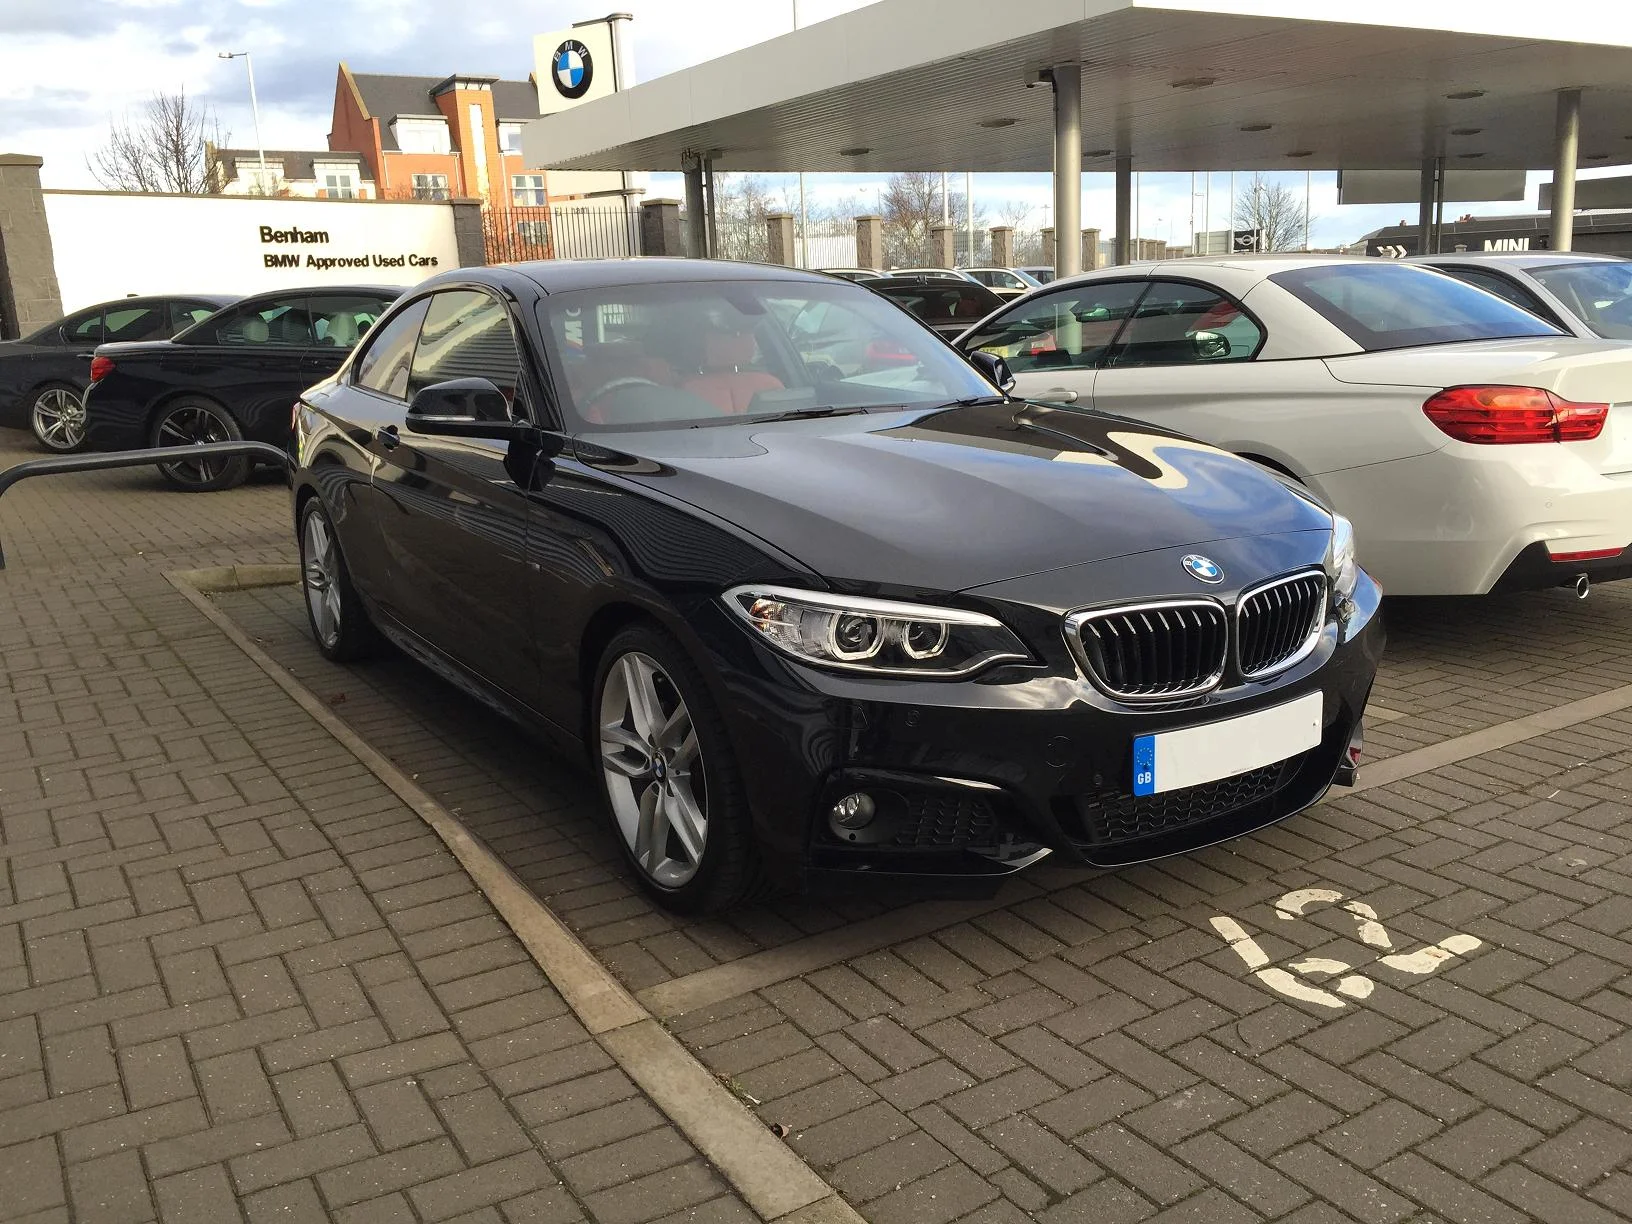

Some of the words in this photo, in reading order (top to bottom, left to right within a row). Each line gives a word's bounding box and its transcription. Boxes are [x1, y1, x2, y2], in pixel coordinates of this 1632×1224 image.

[553, 40, 588, 62] BMW
[259, 225, 330, 244] Benham
[1484, 237, 1530, 252] MINI
[263, 254, 300, 268] BMW
[306, 254, 369, 270] Approved
[372, 254, 405, 267] Used
[408, 253, 439, 267] Cars
[1137, 771, 1152, 785] GB
